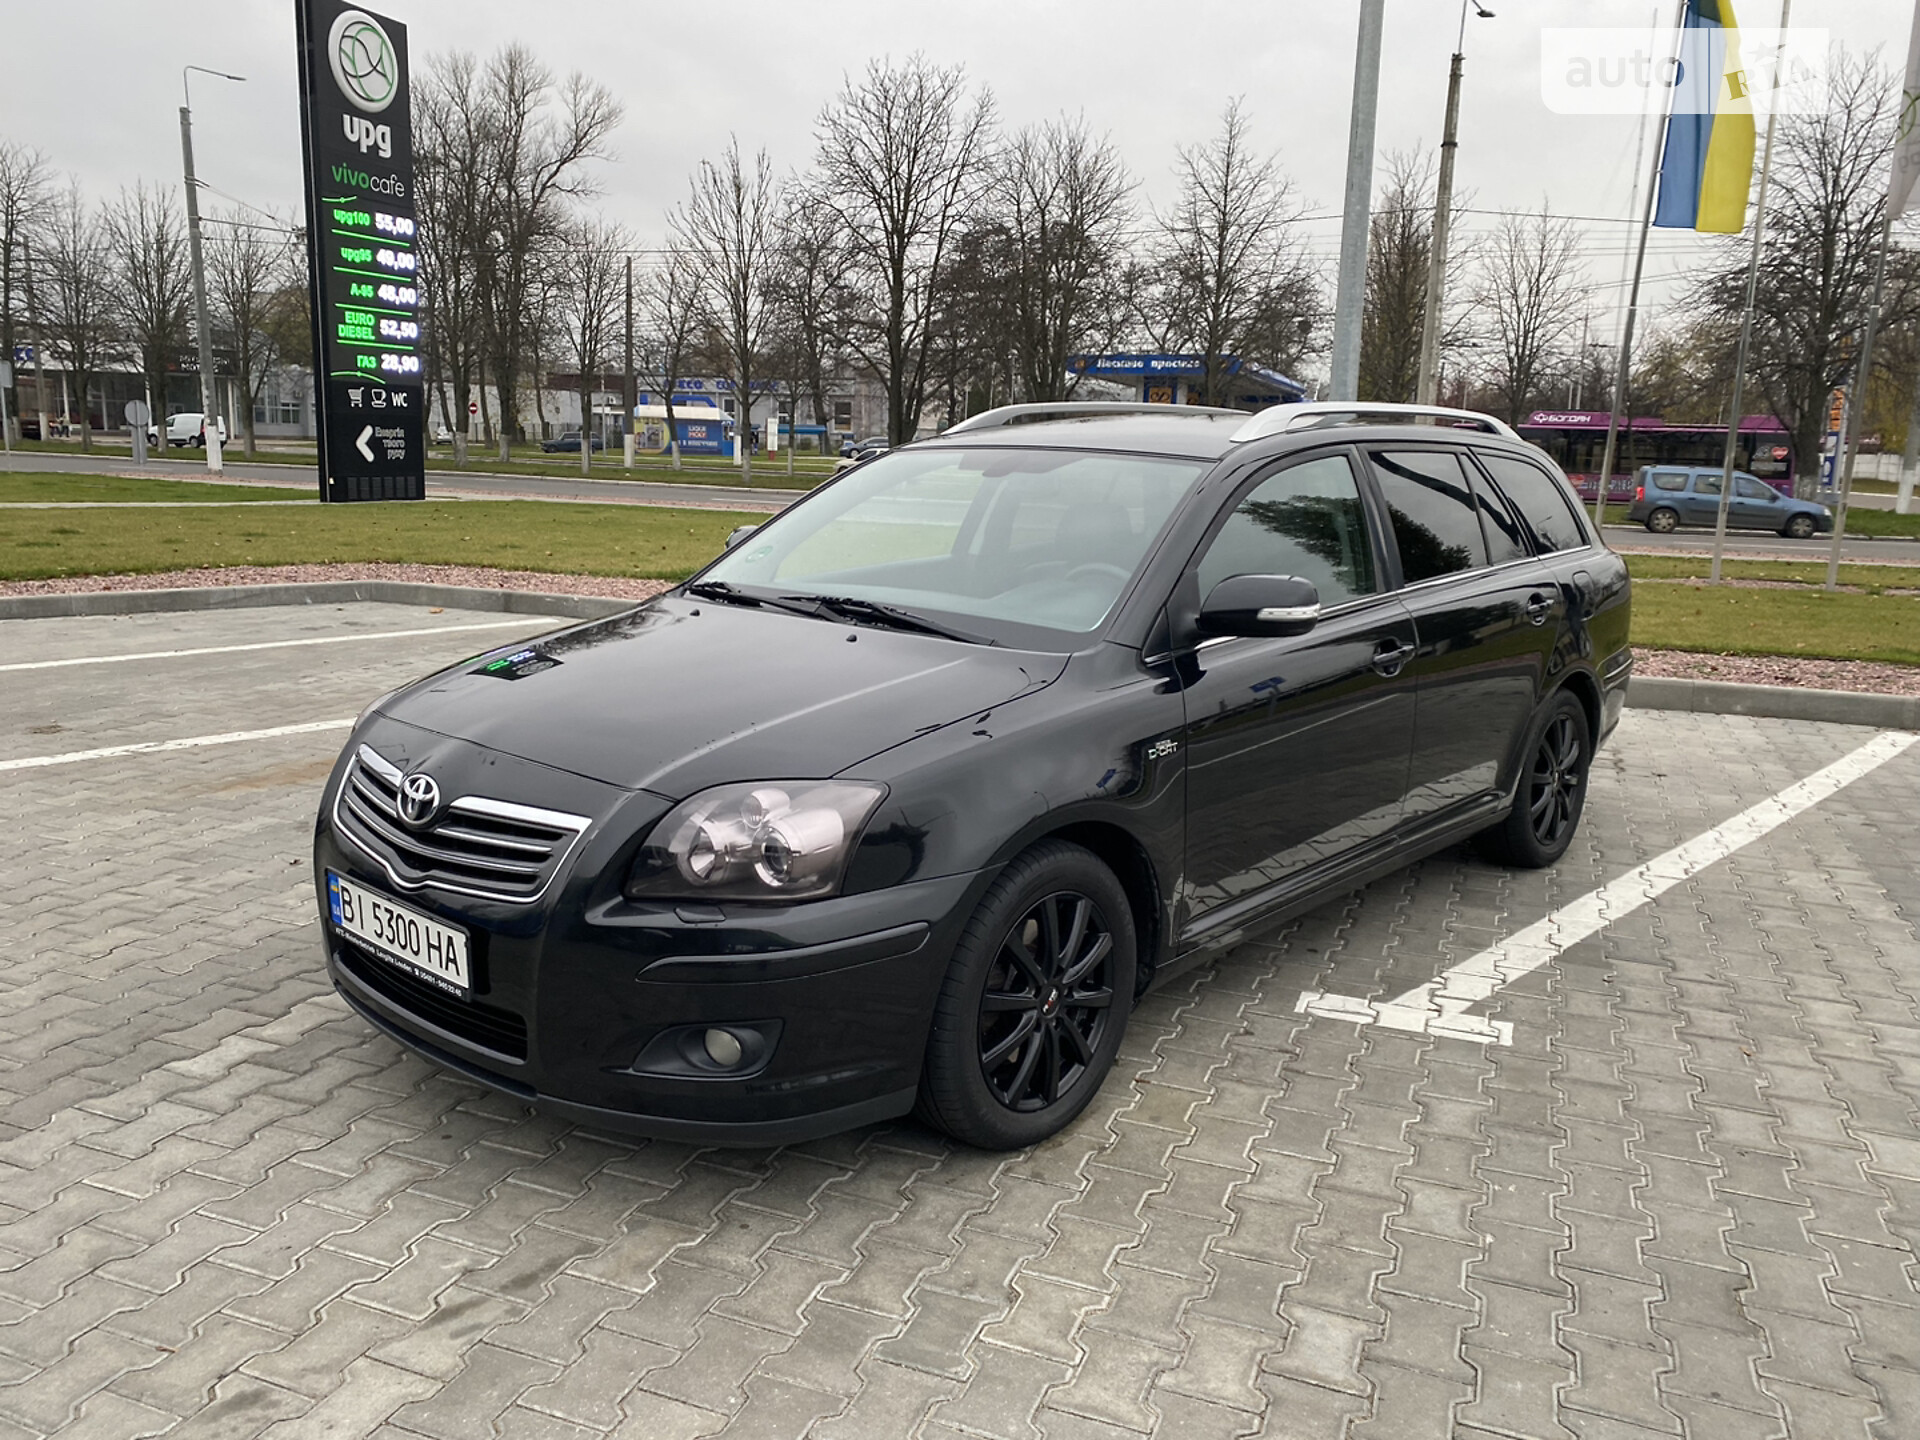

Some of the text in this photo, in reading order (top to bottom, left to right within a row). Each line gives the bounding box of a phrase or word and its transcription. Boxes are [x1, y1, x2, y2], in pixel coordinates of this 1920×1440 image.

[342, 113, 392, 158] upg
[333, 209, 414, 235] upg100 55,00
[340, 247, 415, 271] upg95 49,00
[350, 282, 417, 306] A-95 48,00
[344, 311, 375, 326] EURO
[379, 319, 418, 340] 52,50
[338, 324, 376, 340] DIESEL
[356, 353, 420, 374] ГАЗ 28,90
[391, 392, 408, 407] WC
[340, 884, 364, 931] BI
[372, 900, 421, 957] 5300
[425, 925, 461, 977] HA
